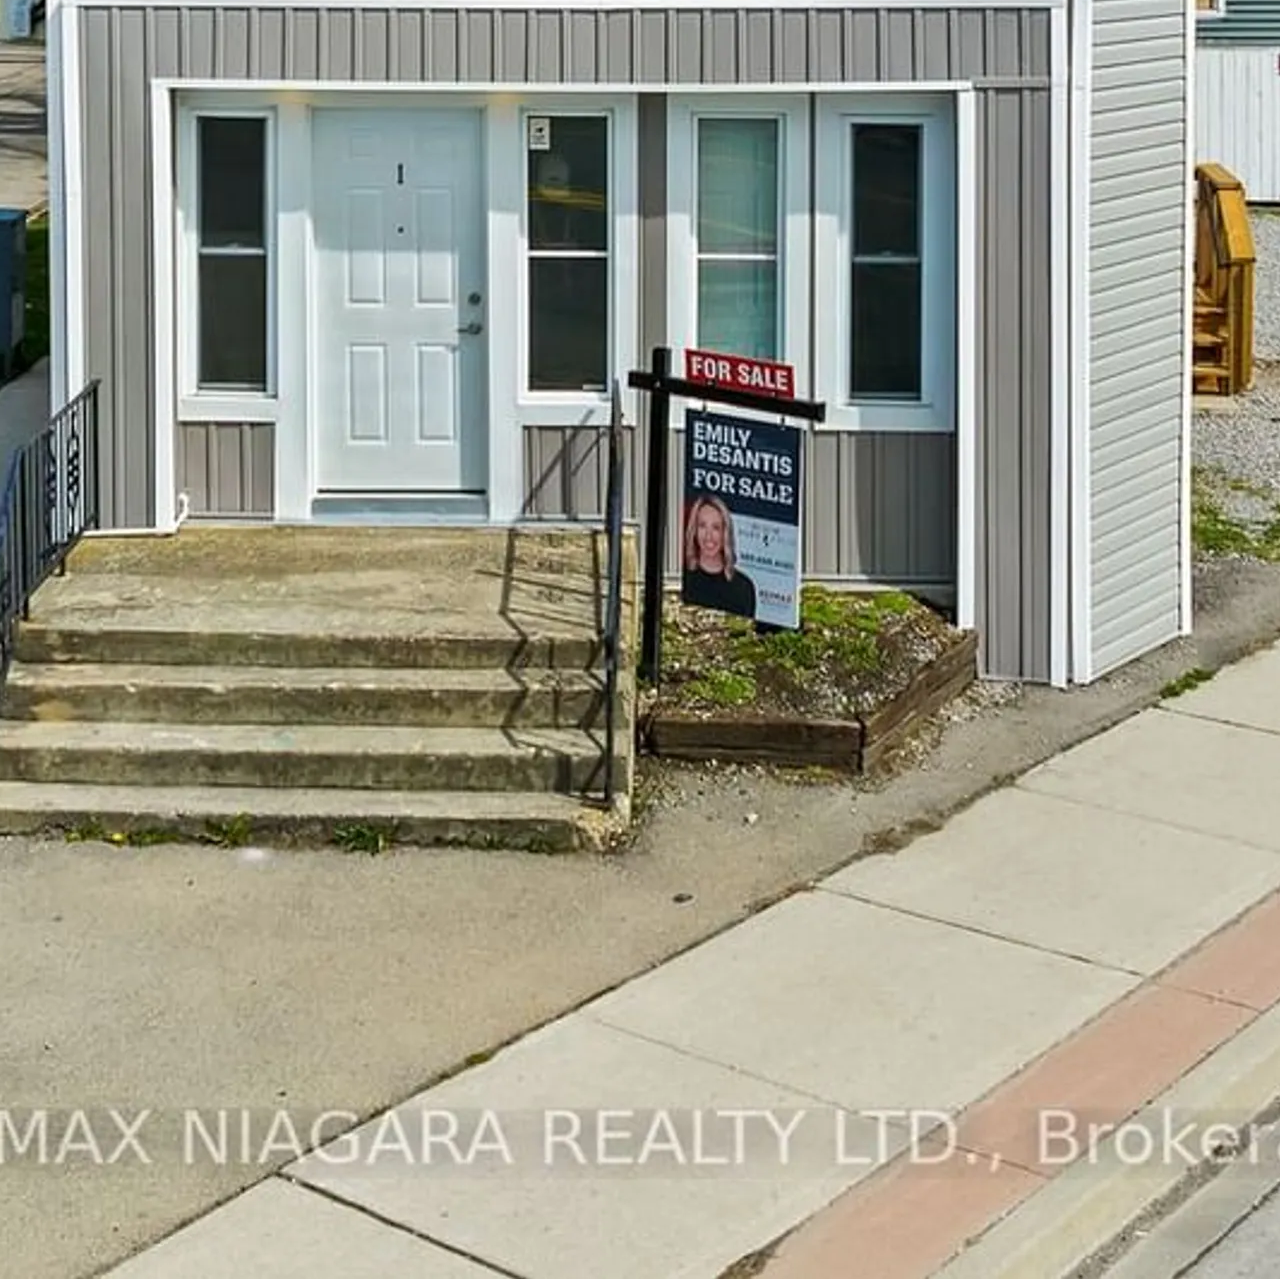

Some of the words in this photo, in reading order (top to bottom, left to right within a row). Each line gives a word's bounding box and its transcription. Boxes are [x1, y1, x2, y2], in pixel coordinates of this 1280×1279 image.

[691, 356, 732, 382] FOR
[737, 362, 789, 391] SALE
[693, 422, 751, 448] EMILY
[692, 442, 793, 475] DESANTIS
[692, 468, 736, 494] FOR
[738, 478, 793, 505] SALE
